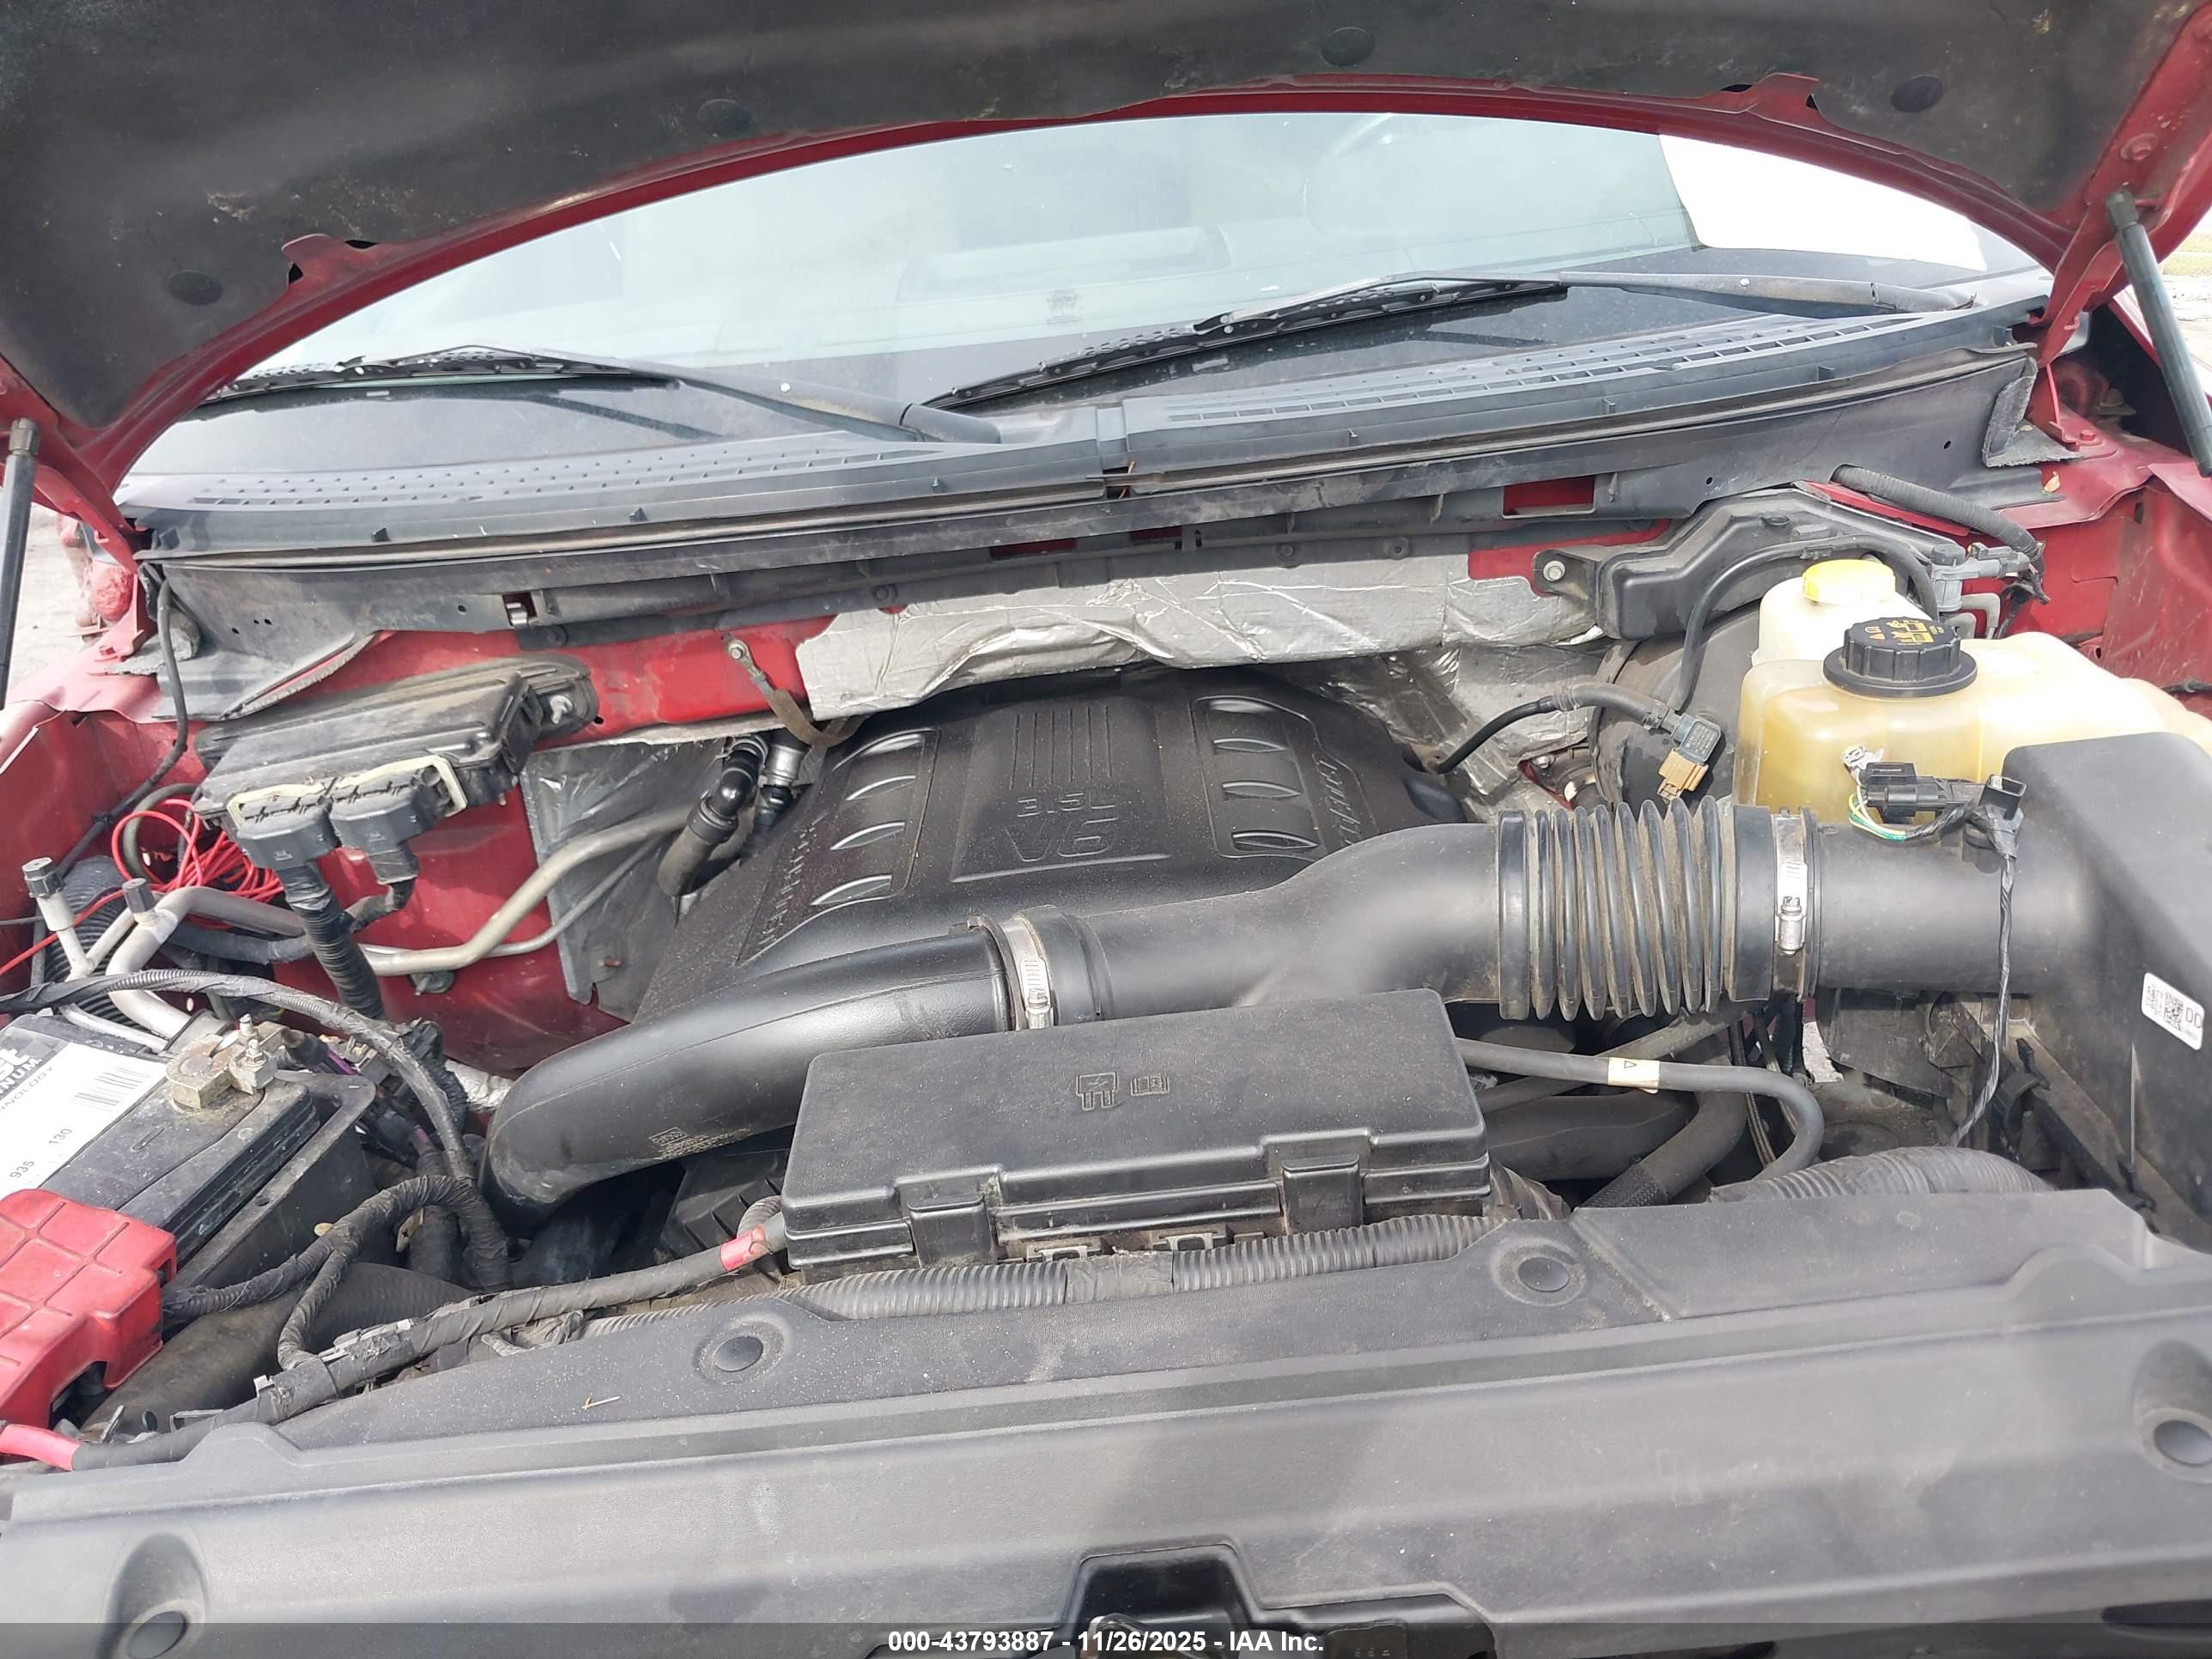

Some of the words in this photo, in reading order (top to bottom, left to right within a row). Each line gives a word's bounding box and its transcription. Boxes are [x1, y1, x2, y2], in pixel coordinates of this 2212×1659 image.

[1017, 789, 1117, 818] 3.5L
[1003, 816, 1120, 863] V6
[49, 1128, 72, 1144] 130
[9, 1160, 35, 1178] 935
